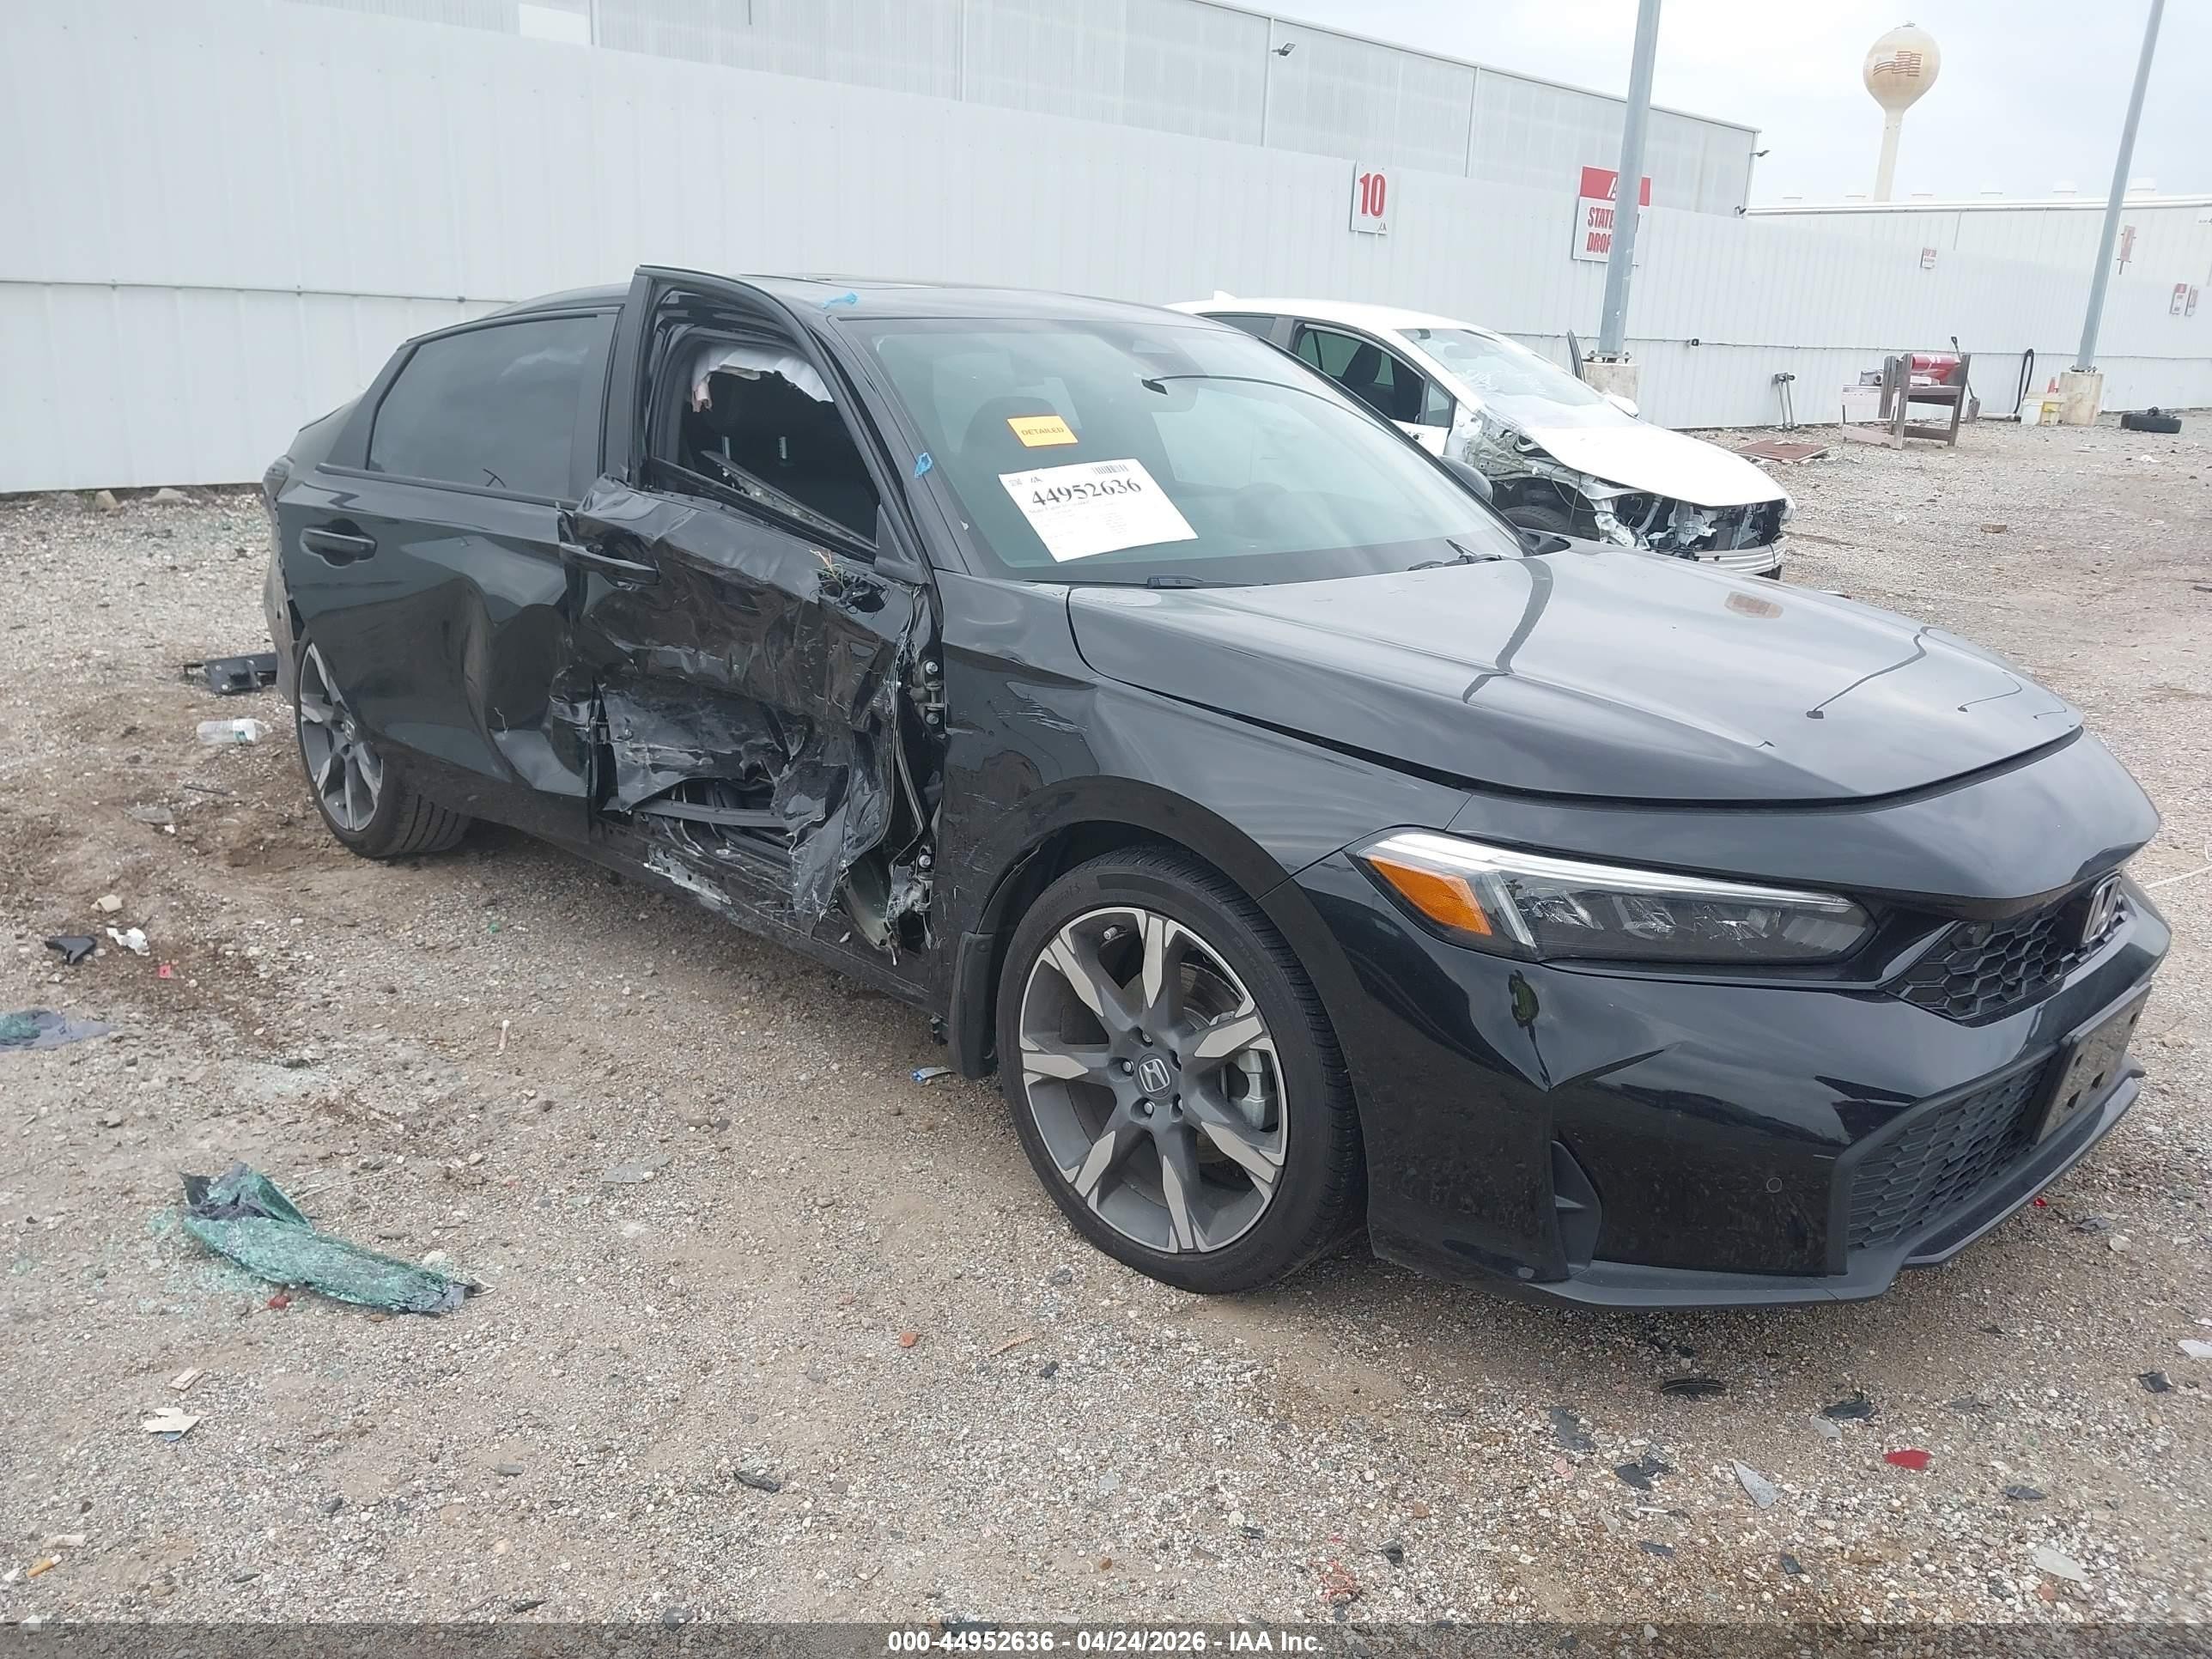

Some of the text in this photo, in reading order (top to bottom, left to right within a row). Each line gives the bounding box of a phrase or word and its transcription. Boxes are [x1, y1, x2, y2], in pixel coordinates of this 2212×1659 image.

[1358, 173, 1386, 218] 10
[1021, 426, 1065, 435] DETAILED
[1032, 477, 1142, 506] 44952636
